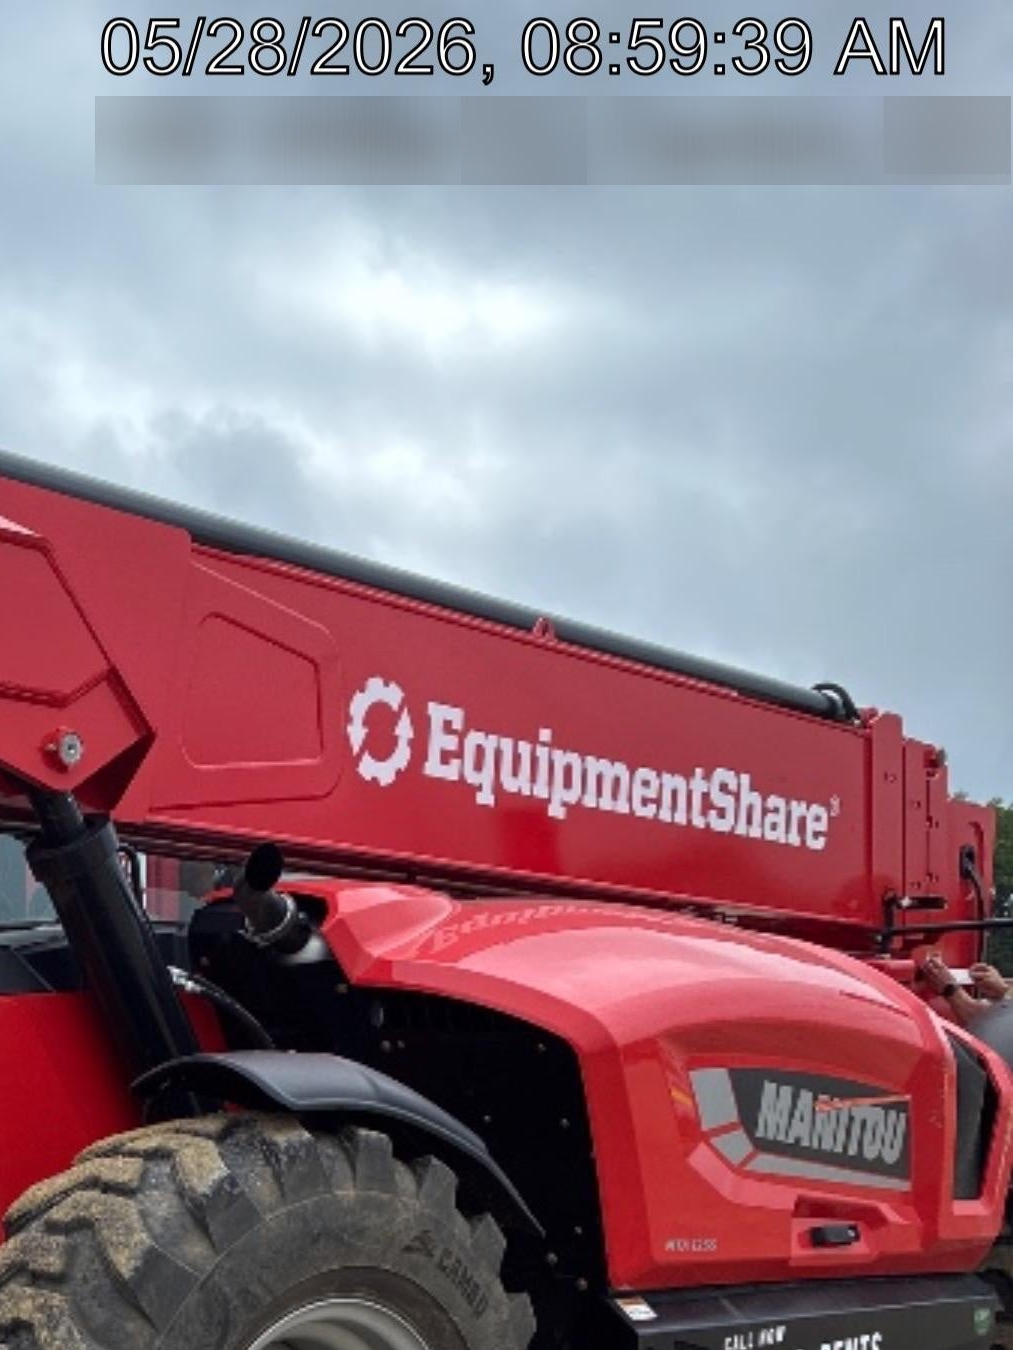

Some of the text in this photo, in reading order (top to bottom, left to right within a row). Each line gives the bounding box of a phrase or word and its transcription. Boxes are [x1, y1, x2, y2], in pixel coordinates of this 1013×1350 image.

[423, 701, 830, 851] EquipmentShare
[754, 1079, 908, 1166] MANITOU
[757, 1324, 787, 1348] NOW
